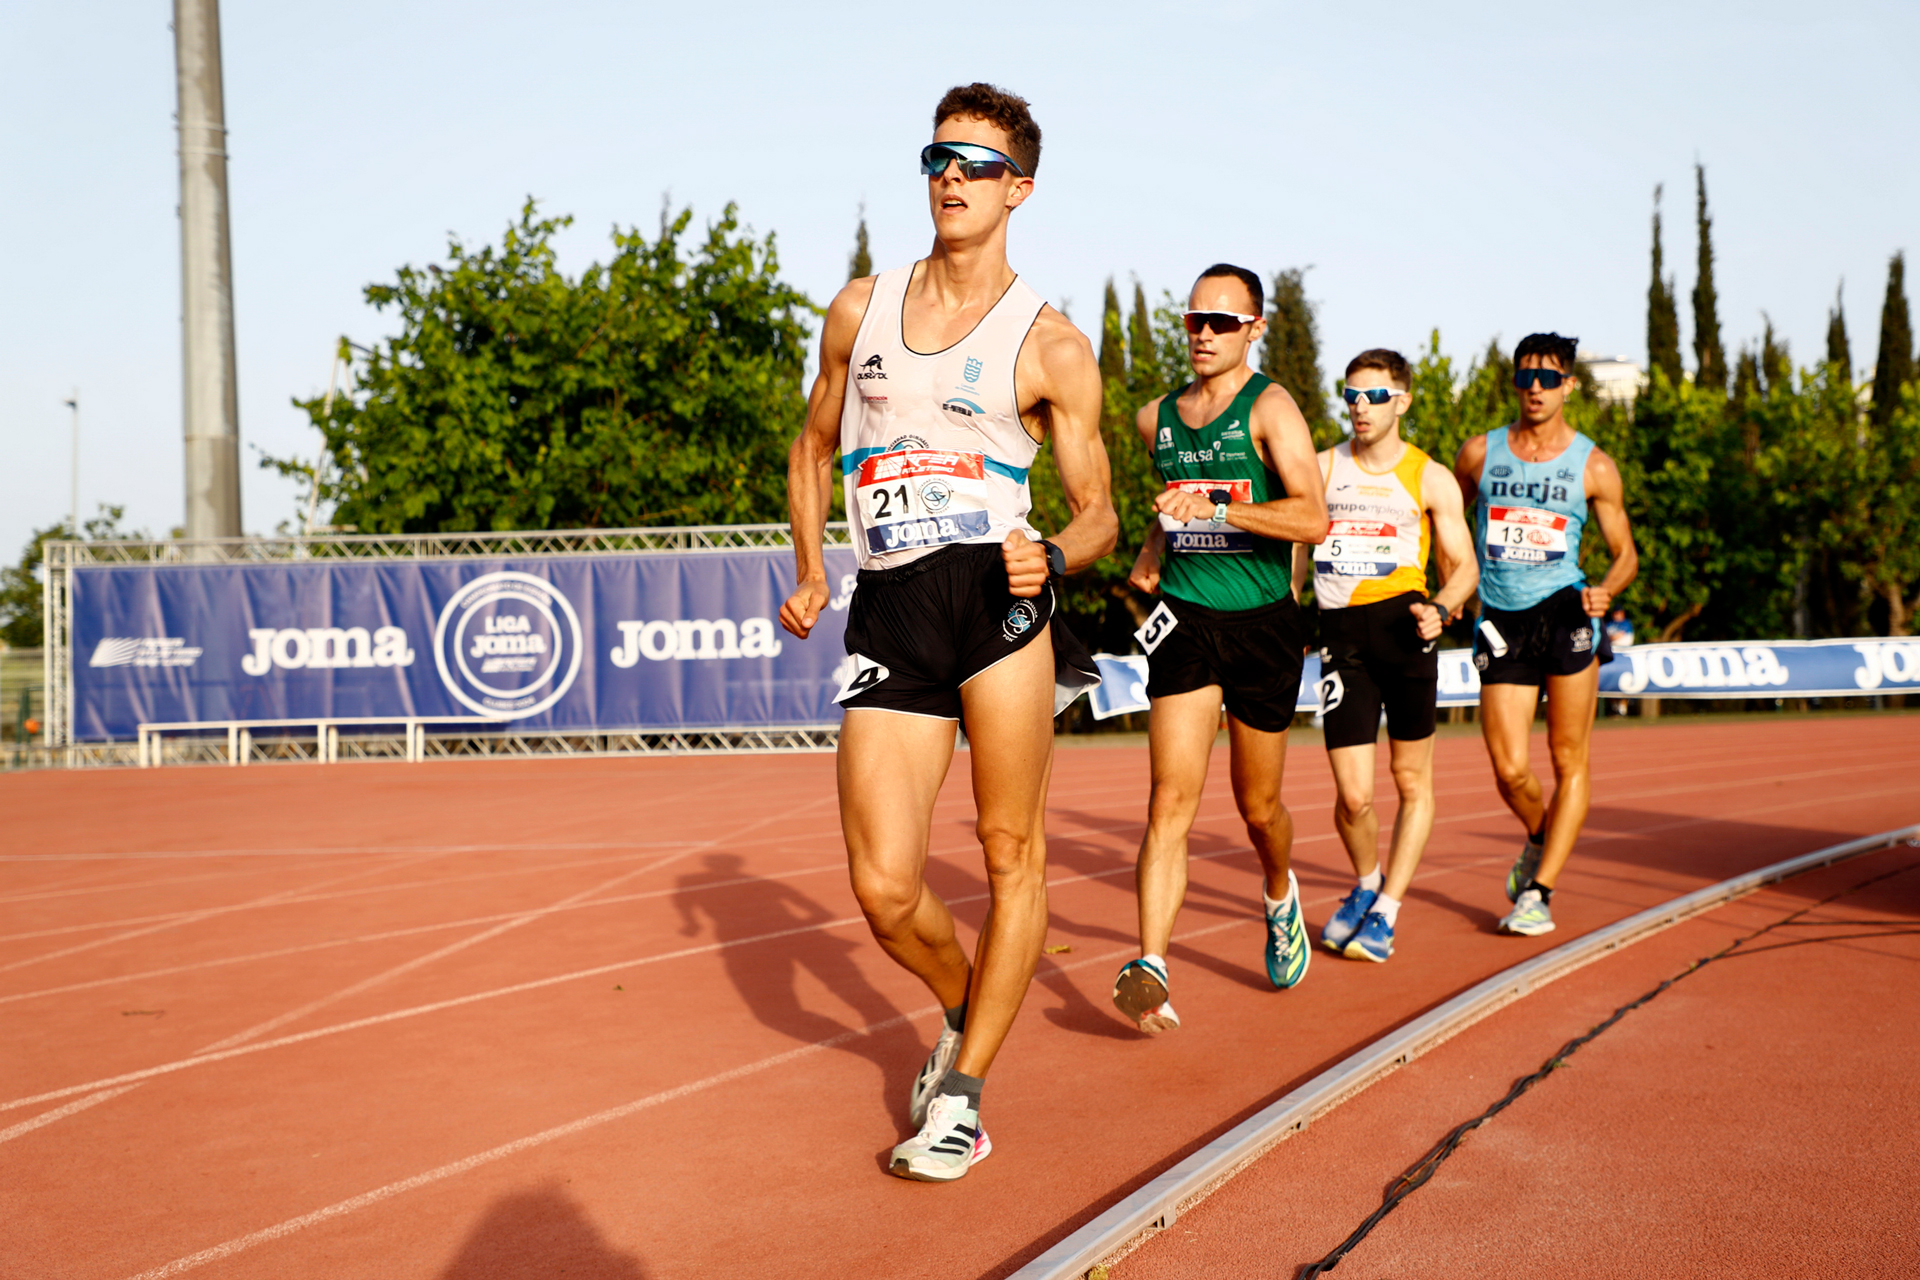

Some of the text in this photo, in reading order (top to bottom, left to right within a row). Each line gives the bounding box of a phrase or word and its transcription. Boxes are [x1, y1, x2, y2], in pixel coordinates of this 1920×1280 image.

[872, 484, 909, 519] 21
[1490, 477, 1567, 504] nerja
[886, 518, 959, 548] Joma
[1173, 533, 1229, 549] Joma
[1502, 526, 1523, 544] 13
[1331, 539, 1342, 557] 5
[1501, 546, 1547, 561] Joma
[485, 615, 531, 633] LIGA
[1145, 612, 1170, 644] 5
[241, 625, 415, 676] Joma
[470, 634, 547, 658] Joma
[610, 617, 782, 668] Joma
[847, 666, 879, 691] 4
[1618, 646, 1789, 694] Joma
[1853, 642, 1920, 690] Jo
[1322, 680, 1338, 710] 2
